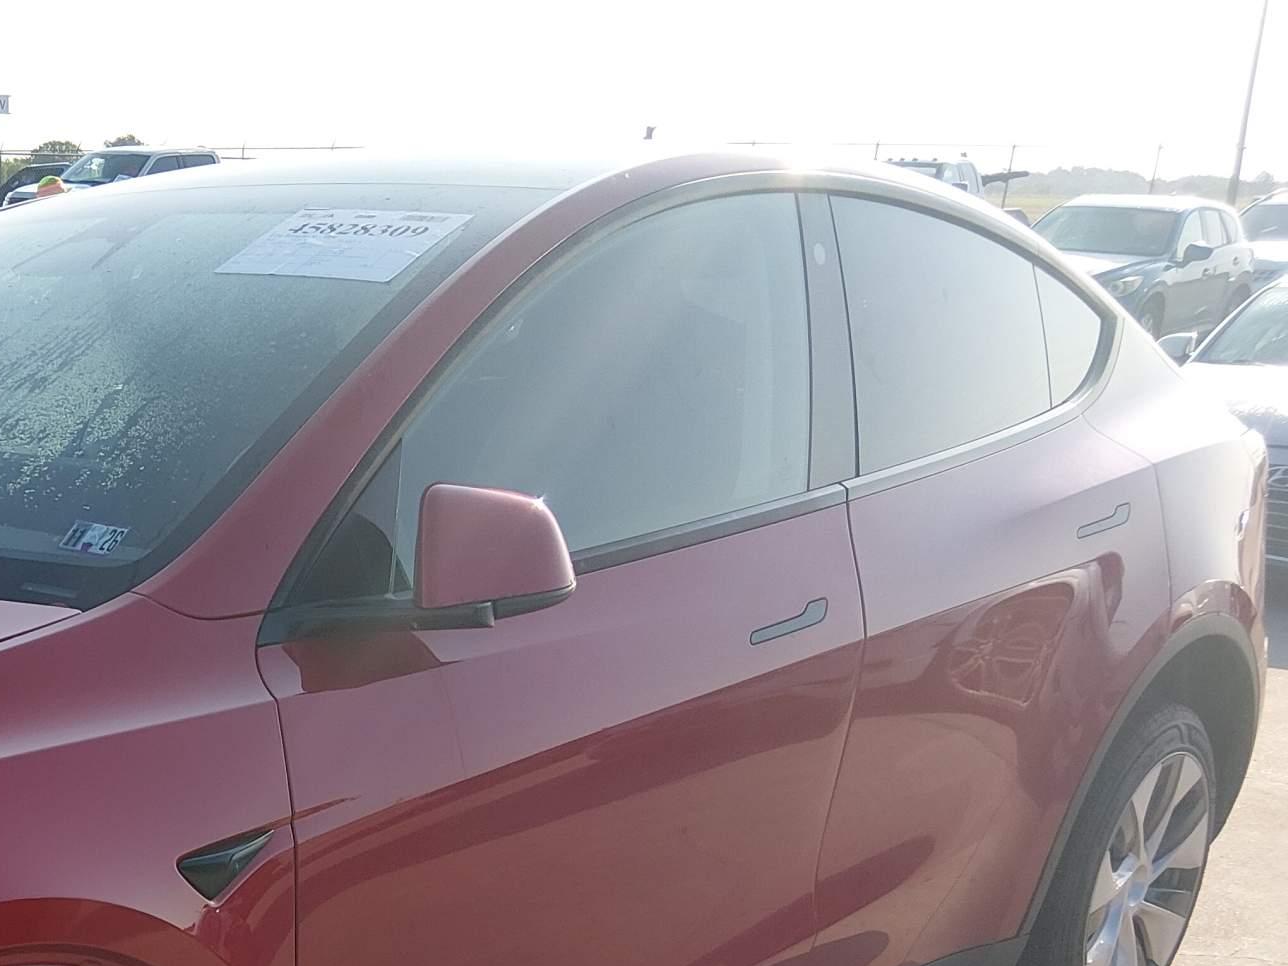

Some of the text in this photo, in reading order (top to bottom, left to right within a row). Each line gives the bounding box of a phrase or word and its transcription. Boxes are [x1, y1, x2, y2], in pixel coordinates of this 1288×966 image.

[0, 99, 6, 110] V
[288, 221, 431, 238] 45828309
[99, 529, 125, 552] 26
